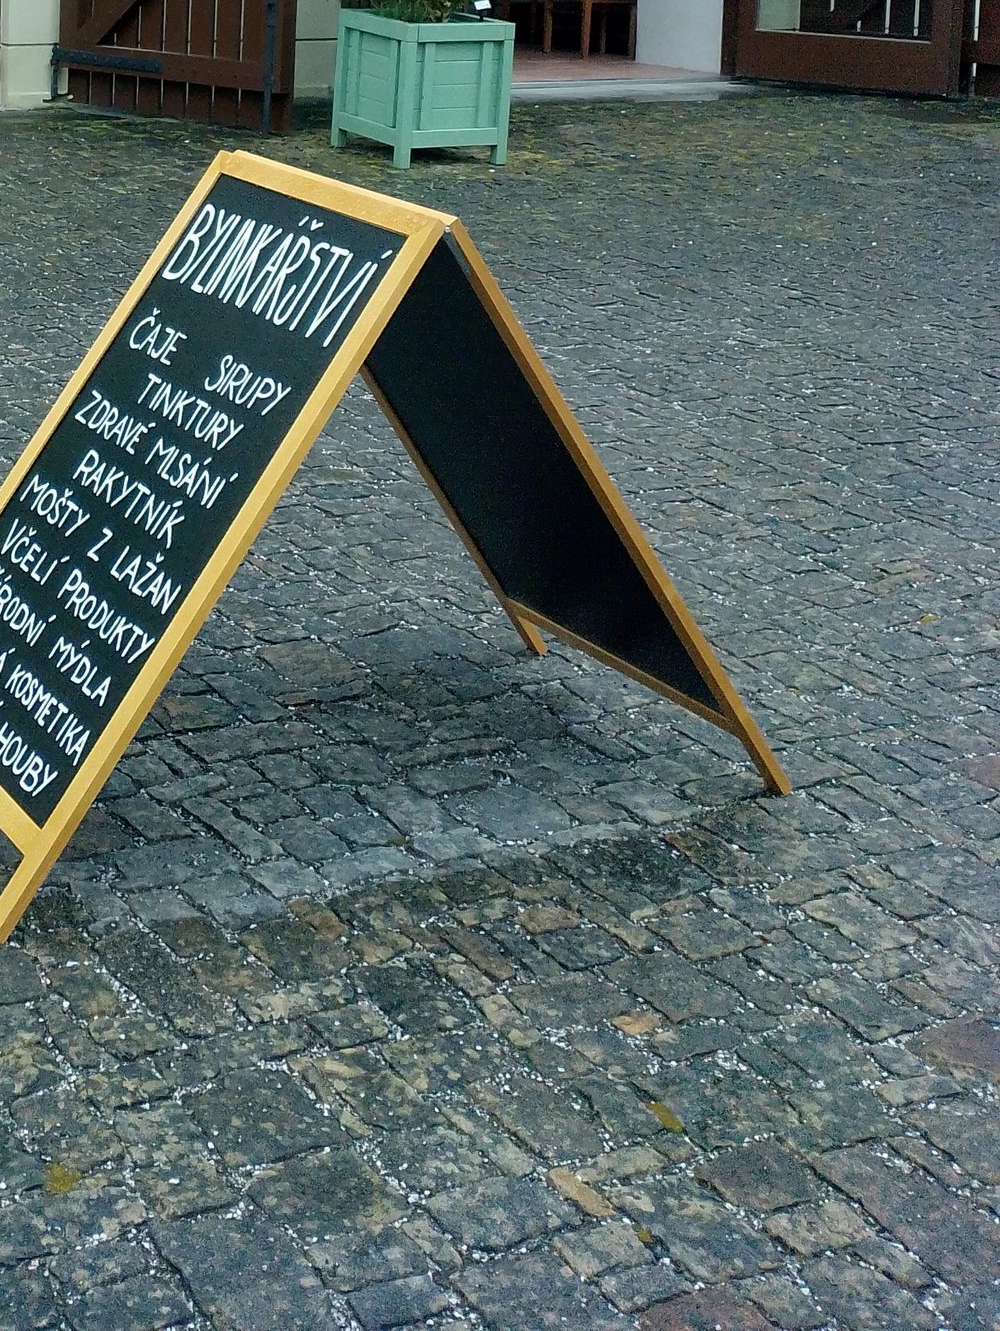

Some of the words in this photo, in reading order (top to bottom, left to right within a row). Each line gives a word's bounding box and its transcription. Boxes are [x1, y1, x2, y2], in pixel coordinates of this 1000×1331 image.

[162, 203, 393, 348] BYLINKÁŘSTVÍ
[129, 308, 188, 365] ČAJE
[204, 355, 292, 416] SIRUPY
[137, 374, 244, 451] TINKTURY
[73, 449, 185, 549] RAKYTNÍK
[75, 390, 156, 455] ZDRAVÉ
[145, 436, 239, 509] MLSÁNÍ
[1, 518, 71, 585] VČELÍ
[57, 568, 156, 664] PRODUKTY
[20, 474, 90, 537] MOŠTY
[87, 527, 113, 562] Z
[110, 545, 182, 614] LAŽAN
[4, 664, 91, 766] KOSMETIKA
[48, 636, 112, 707] MÝDLA
